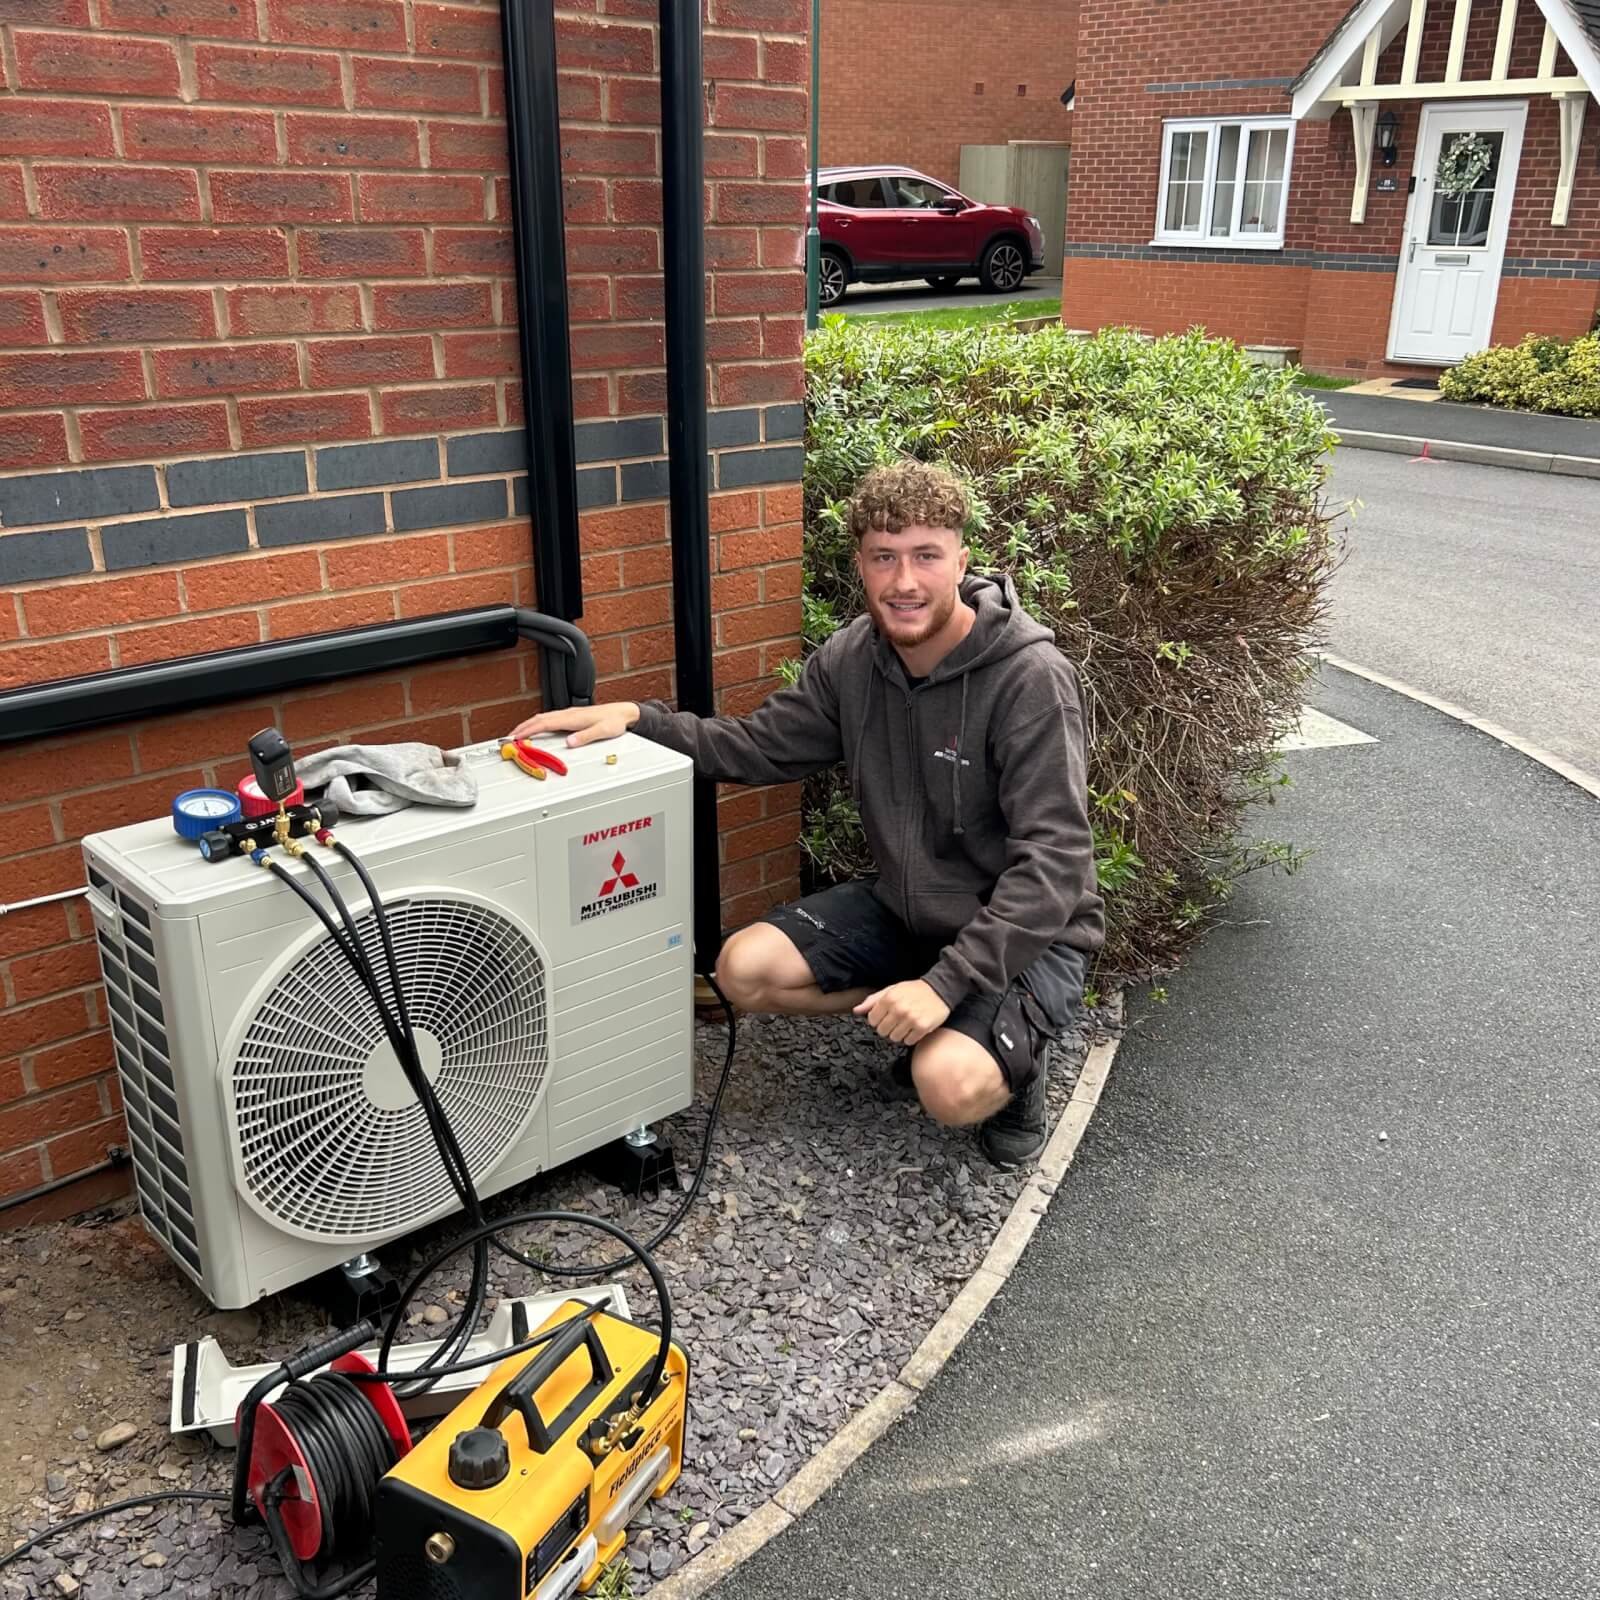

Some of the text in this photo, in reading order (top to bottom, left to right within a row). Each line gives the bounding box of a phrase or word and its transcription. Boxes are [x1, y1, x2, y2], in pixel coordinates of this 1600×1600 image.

[582, 816, 653, 846] INVERTER
[580, 882, 657, 915] MITSUBISHI
[580, 891, 657, 921] HEAVY INDUSTRIES
[608, 1430, 662, 1498] Fieldpiece
